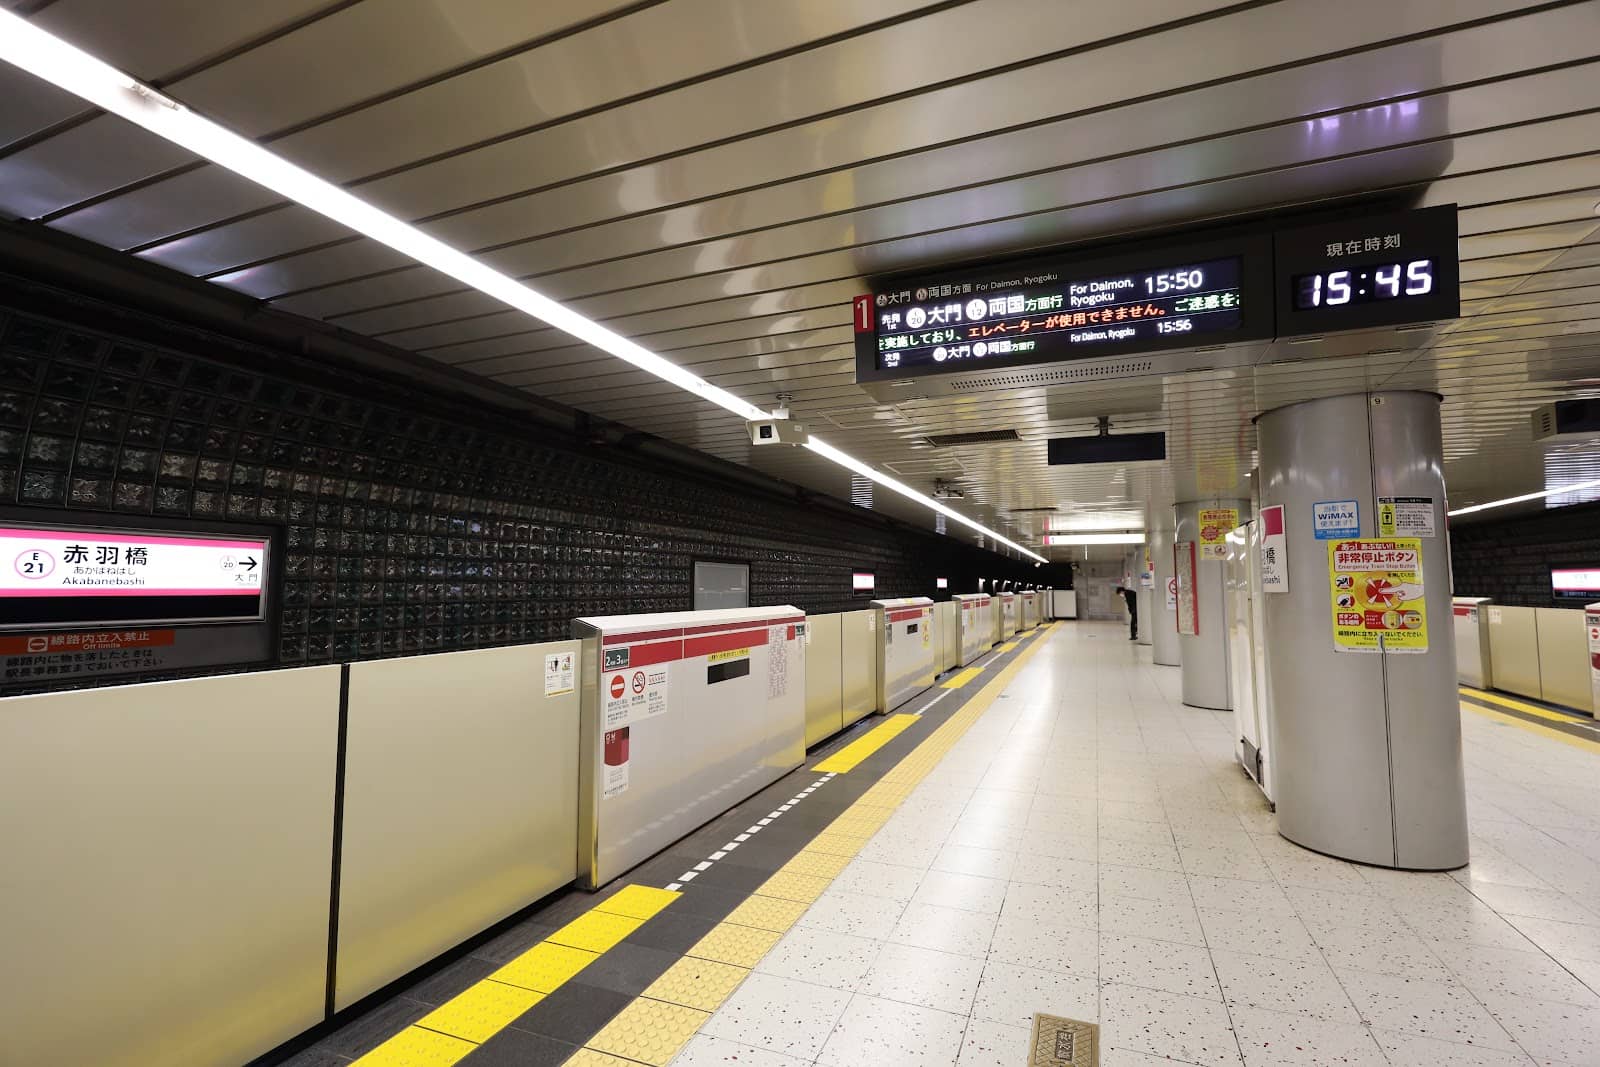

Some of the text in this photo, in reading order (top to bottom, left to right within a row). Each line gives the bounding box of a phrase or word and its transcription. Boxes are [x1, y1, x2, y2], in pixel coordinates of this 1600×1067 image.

[1326, 233, 1401, 257] 現在時刻
[887, 291, 911, 304] 大門
[928, 284, 972, 298] 両国方面
[976, 283, 989, 291] For
[991, 278, 1023, 290] Daimon,
[1024, 273, 1058, 285] Ryogoku
[1312, 259, 1432, 306] 15:45
[928, 303, 961, 324] 大門
[989, 294, 1064, 317] 両国方面行
[1070, 285, 1088, 296] For
[1144, 270, 1204, 294] 15:50
[1070, 291, 1115, 307] Ryogoku
[857, 298, 868, 329] 1
[968, 303, 1165, 338] エレベーターが使用できません。
[1174, 291, 1240, 312] ご迷惑を
[948, 345, 971, 359] 大門
[1071, 333, 1082, 343] For
[1109, 327, 1136, 339] Ryogoku
[1157, 319, 1192, 334] 15:56
[1318, 511, 1353, 520] WiMAX
[32, 552, 39, 561] E
[63, 544, 148, 566] 赤羽橋
[1337, 551, 1415, 564] 非常停止ボタン
[23, 562, 44, 573] 21
[62, 576, 145, 586] Akabanebashi
[51, 631, 150, 646] 線路内立入禁止
